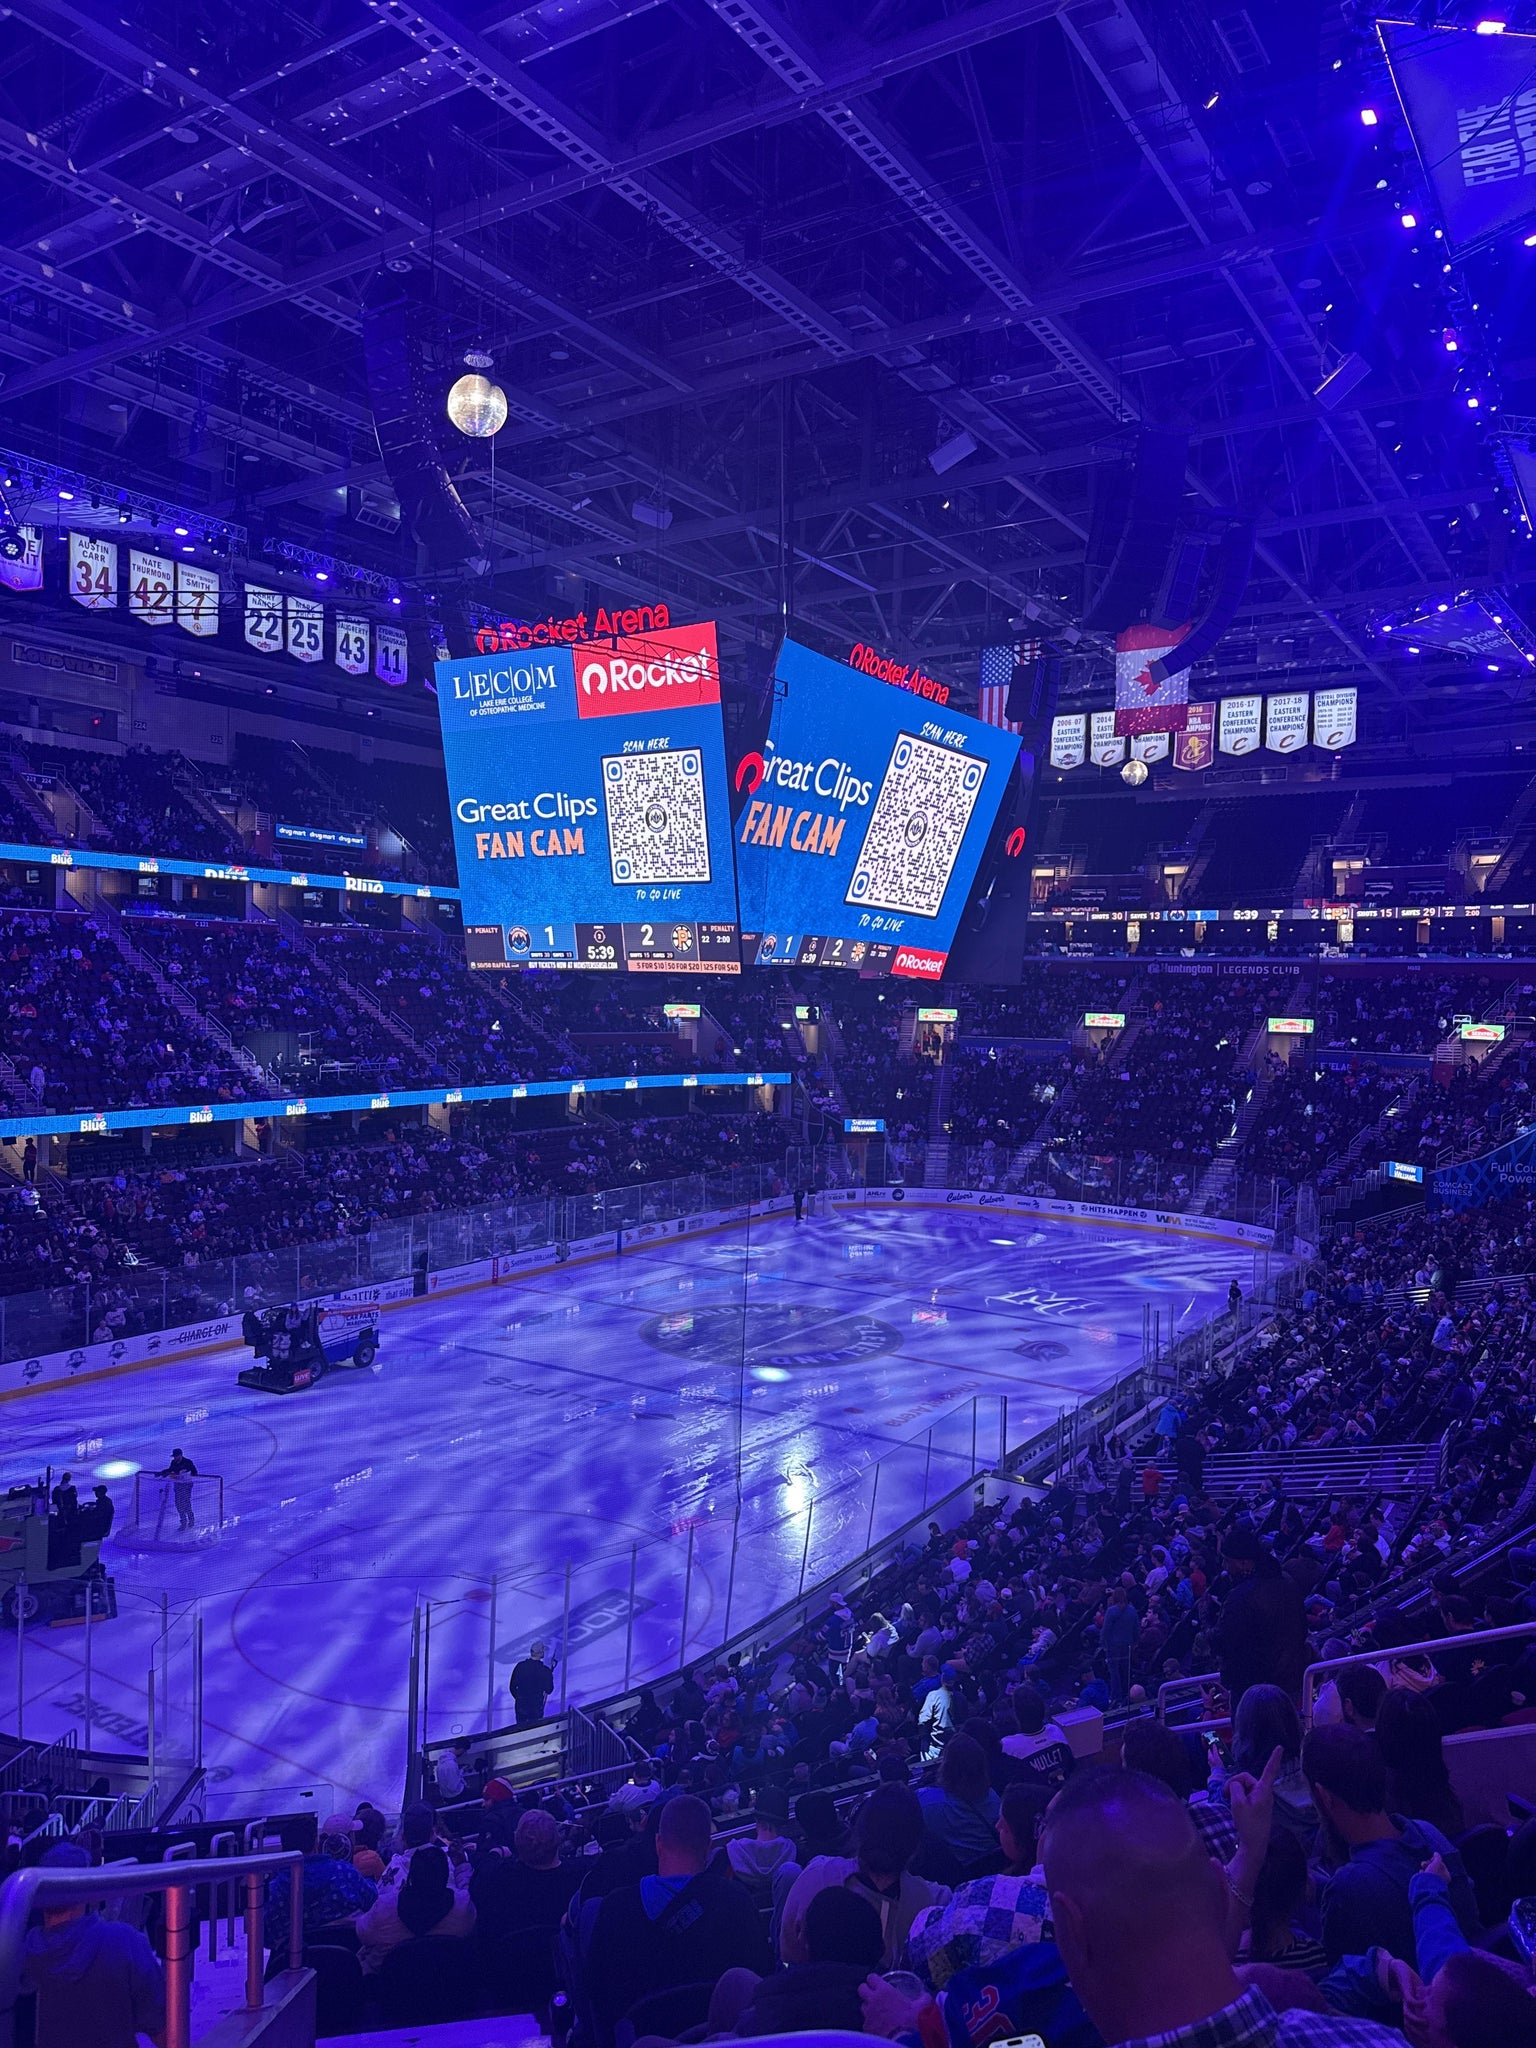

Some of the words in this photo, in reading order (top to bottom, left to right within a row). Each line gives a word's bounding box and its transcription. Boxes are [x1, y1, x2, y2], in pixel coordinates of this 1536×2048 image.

[79, 540, 109, 554] AUSTIN
[83, 551, 106, 562] CARR
[142, 557, 162, 569] NATE
[132, 563, 171, 580] THURMOND
[76, 560, 112, 599] 34
[186, 578, 211, 591] SMITH
[135, 577, 168, 612] 42
[191, 590, 205, 620] 7
[249, 610, 279, 641] 22
[501, 611, 589, 651] Rocket
[593, 603, 670, 637] Arena
[292, 619, 320, 651] 25
[340, 631, 366, 664] 43
[382, 646, 401, 674] 11
[609, 647, 712, 693] Rocket
[862, 646, 909, 688] Rocket
[908, 669, 950, 704] Arena
[479, 699, 495, 708] LAKE
[495, 697, 507, 706] ERIE
[508, 694, 534, 704] COLLEGE
[1227, 700, 1255, 709] 2016-17
[1273, 697, 1302, 706] 2017-18
[1318, 698, 1354, 707] CHAMPIONS
[470, 708, 478, 717] OF
[479, 705, 517, 716] OSTEOPATHIC
[518, 702, 546, 712] MEDICINE
[1228, 710, 1253, 718] EASTERN
[1274, 707, 1301, 716] EASTERN
[1222, 718, 1258, 727] CONFERENCE
[1269, 714, 1306, 724] CONFERENCE
[1186, 723, 1211, 732] AMPIONS
[1224, 726, 1257, 735] CHAMPIONS
[1270, 723, 1304, 732] CHAMPIONS
[920, 721, 942, 740] SCAN
[944, 728, 968, 749] HERE
[1053, 734, 1085, 743] CONFERENCE
[622, 739, 645, 752] SCAN
[647, 737, 670, 750] HERE
[1054, 743, 1083, 751] CHAMPIONS
[1093, 739, 1123, 747] CHAMPIONS
[814, 758, 873, 812] Clips
[456, 798, 531, 823] Great
[533, 792, 598, 824] Clips
[741, 801, 793, 847] FAN
[790, 810, 847, 856] CAM
[476, 830, 525, 859] FAN
[530, 827, 585, 857] CAM
[51, 853, 73, 866] Blue
[139, 860, 159, 873] Blue
[291, 875, 309, 886] Blue
[636, 889, 646, 900] TO
[650, 889, 661, 900] GO
[663, 888, 682, 900] LIVE
[1112, 912, 1123, 920] 30
[1196, 910, 1202, 919] 1
[1233, 909, 1258, 920] 5:39
[1310, 909, 1319, 919] 2
[1380, 908, 1392, 918] 15
[1401, 909, 1420, 917] SAVES
[1423, 908, 1436, 917] 29
[858, 914, 870, 927] TO
[871, 916, 884, 932] GO
[884, 918, 905, 932] LIVE
[544, 925, 555, 945] 1
[640, 924, 655, 946] 2
[701, 935, 710, 943] 22
[716, 935, 730, 943] 2:00
[587, 945, 615, 960] 5:39
[785, 935, 793, 953] 1
[832, 939, 843, 957] 2
[801, 953, 817, 963] 5:39
[906, 953, 943, 973] Rocket
[654, 962, 664, 970] $10
[688, 963, 699, 971] $20
[727, 964, 739, 972] $40
[1163, 963, 1213, 976] Huntington
[1223, 965, 1270, 975] LEGENDS
[286, 1103, 307, 1116] Blue
[371, 1097, 390, 1109] Blue
[190, 1109, 213, 1124] Blue
[80, 1118, 107, 1132] Blue
[1490, 1162, 1512, 1173] Full
[1433, 1180, 1473, 1190] COMCAST
[1433, 1187, 1473, 1197] BUSINESS
[1088, 1205, 1106, 1214] HITS
[1107, 1207, 1138, 1217] HAPPEN
[1155, 1213, 1182, 1225] WM
[178, 1327, 213, 1344] CHARGE
[213, 1322, 228, 1336] ON
[1029, 1748, 1063, 1771] MULLET
